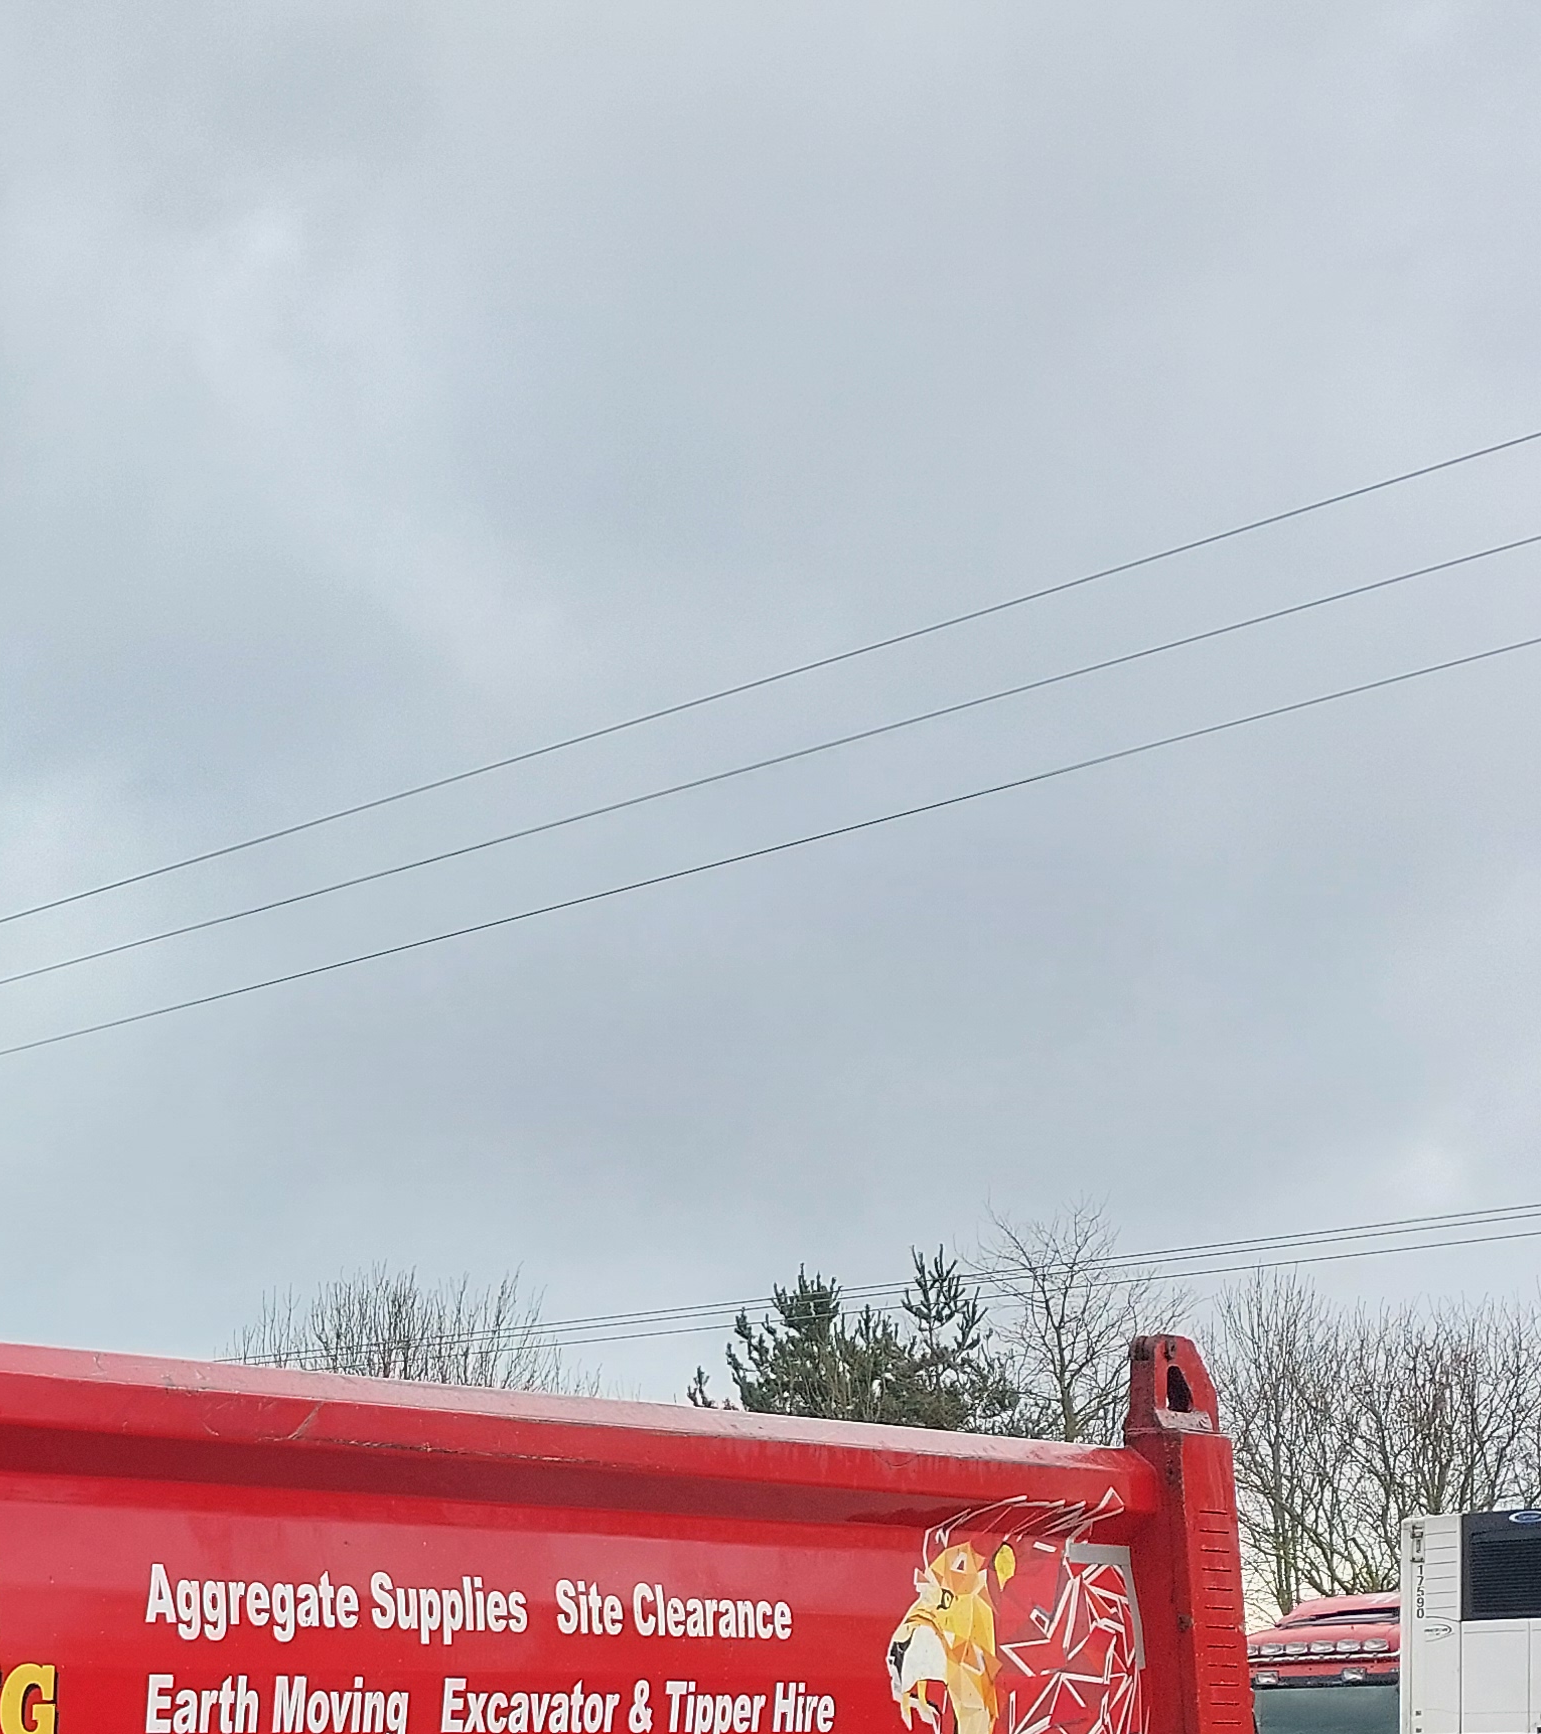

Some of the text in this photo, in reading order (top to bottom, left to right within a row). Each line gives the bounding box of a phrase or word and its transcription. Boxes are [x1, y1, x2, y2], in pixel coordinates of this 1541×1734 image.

[145, 1563, 793, 1645] Aggregate Supplies Site Clearance
[145, 1674, 259, 1734] Earth
[440, 1677, 620, 1734] Excavator
[627, 1680, 653, 1734] &
[772, 1682, 836, 1734] Hire
